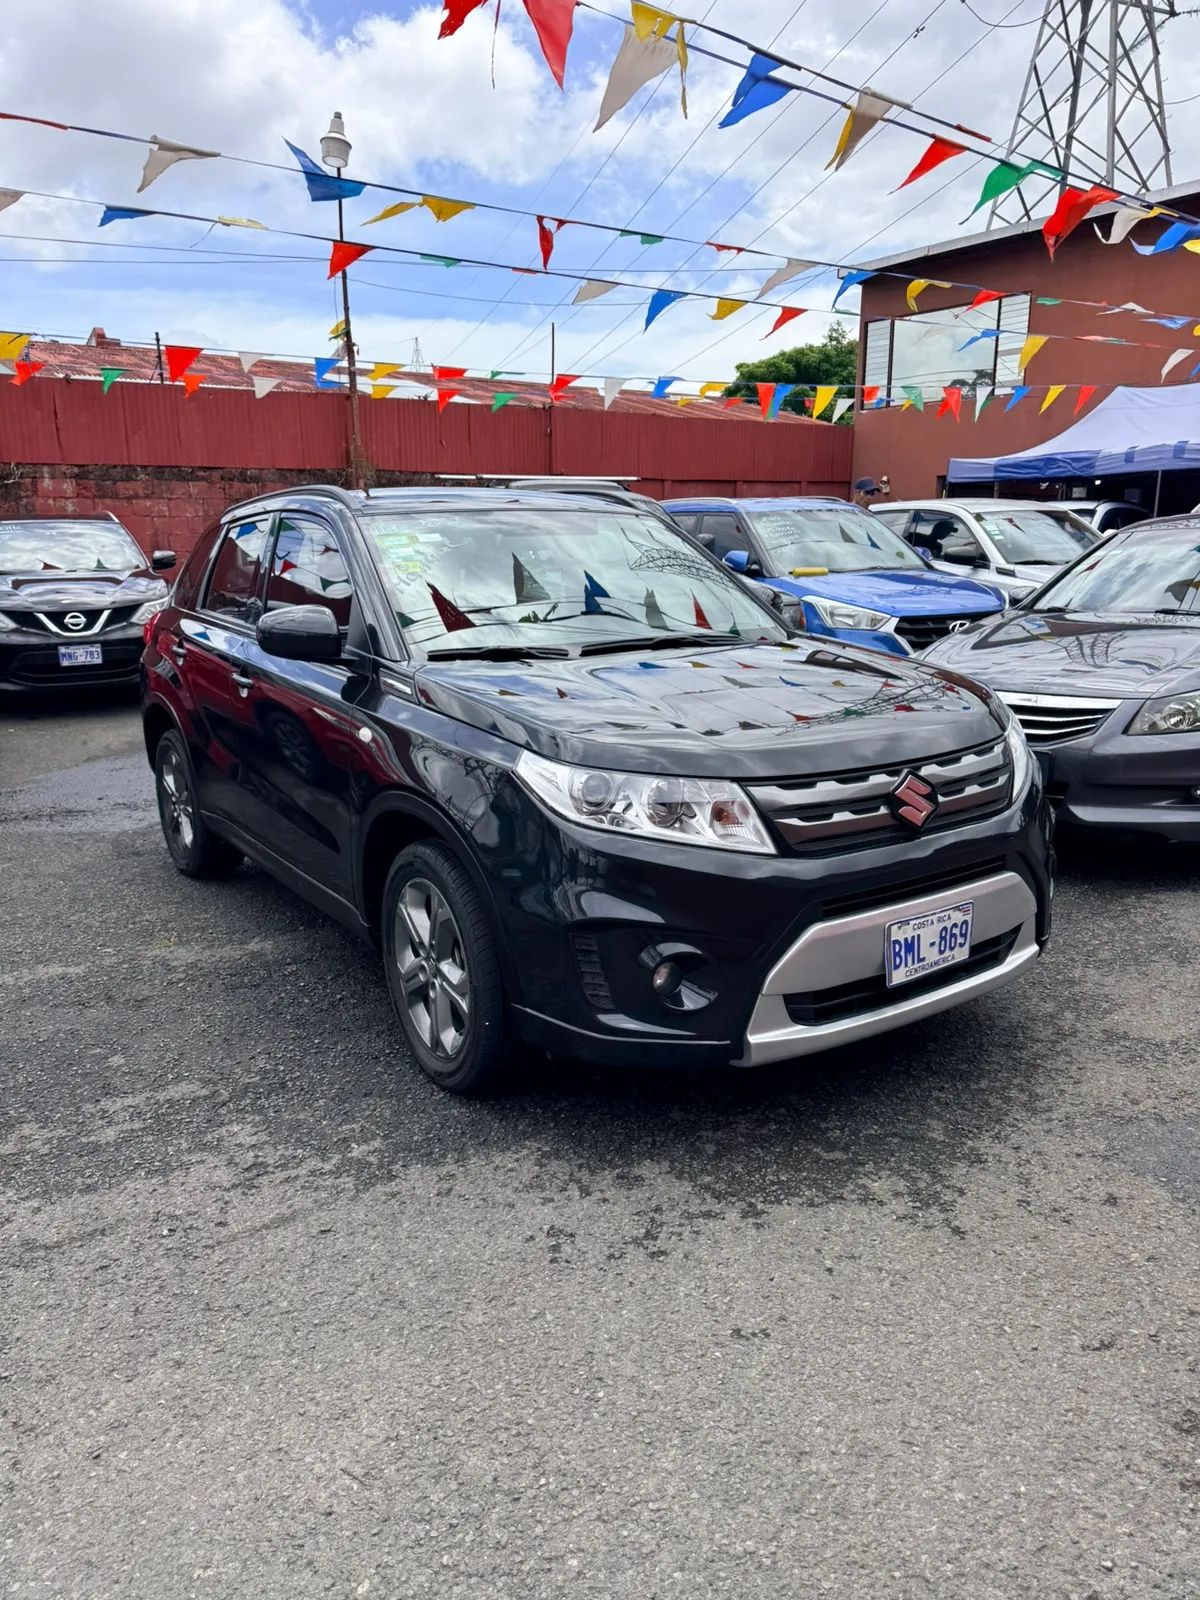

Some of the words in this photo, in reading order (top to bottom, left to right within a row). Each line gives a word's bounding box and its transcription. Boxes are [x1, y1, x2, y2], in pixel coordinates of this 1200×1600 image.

[60, 650, 100, 661] MNG-783
[912, 919, 935, 931] COSTA
[937, 913, 952, 923] RICA
[892, 919, 969, 971] BML-869
[904, 953, 956, 977] CENTROAMERICA
